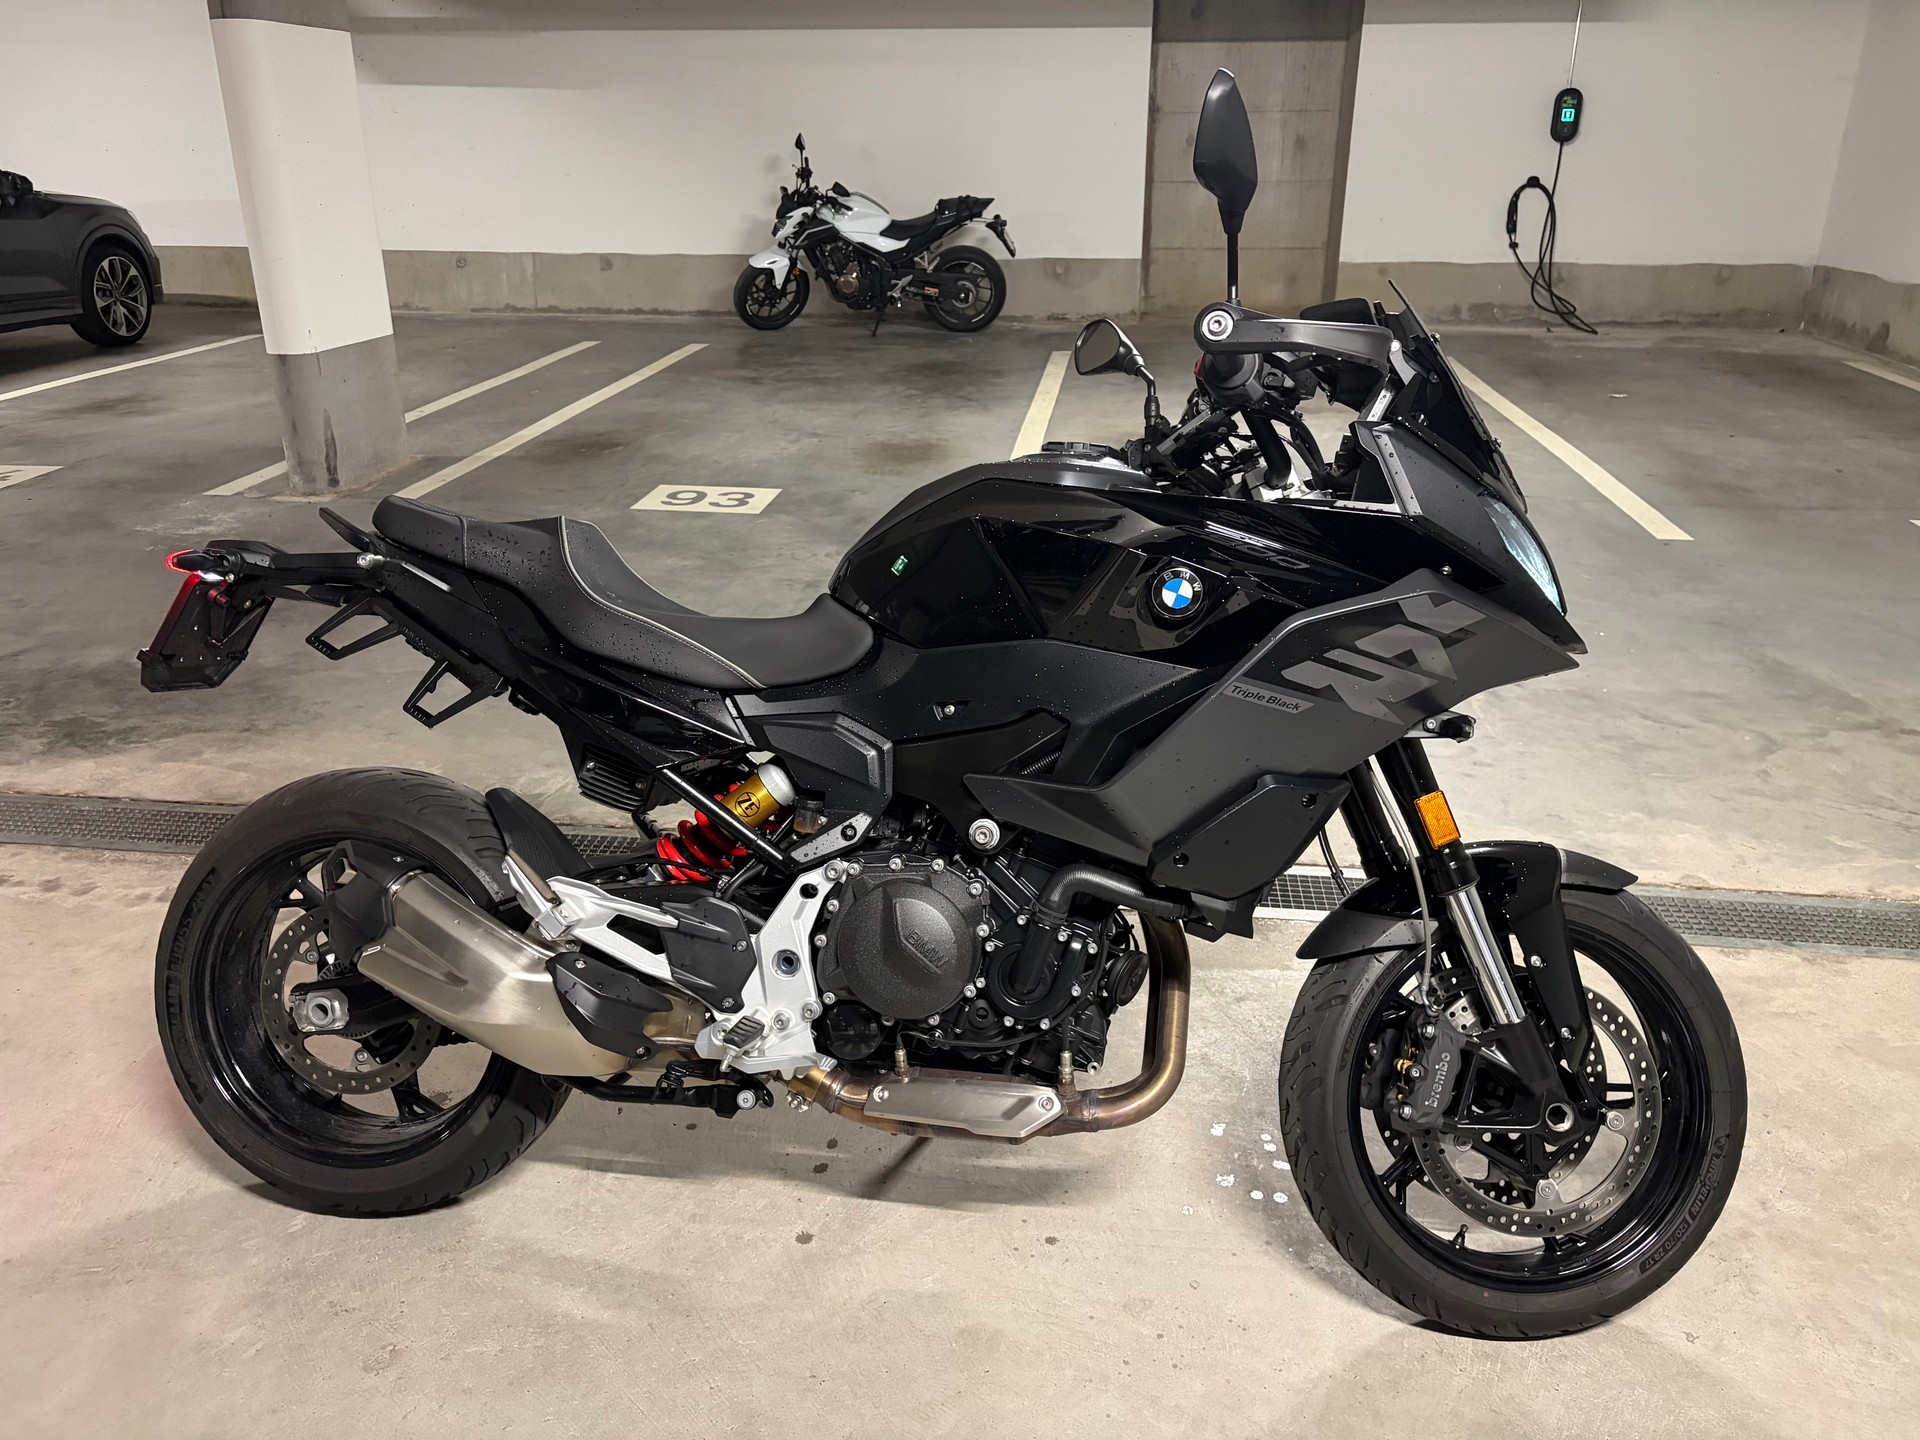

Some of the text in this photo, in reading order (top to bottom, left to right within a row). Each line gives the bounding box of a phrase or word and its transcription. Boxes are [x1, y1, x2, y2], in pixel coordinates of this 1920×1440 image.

[661, 490, 755, 508] 93
[1163, 571, 1202, 592] BMW
[1231, 685, 1302, 712] Triple Black
[735, 792, 760, 817] ZF
[906, 928, 949, 968] BMW
[1343, 991, 1373, 1050] MICHELIN
[1424, 1051, 1451, 1108] brembo
[1663, 1221, 1689, 1250] 120/70
[1643, 1257, 1655, 1268] 17
[1652, 1246, 1666, 1261] ZR
